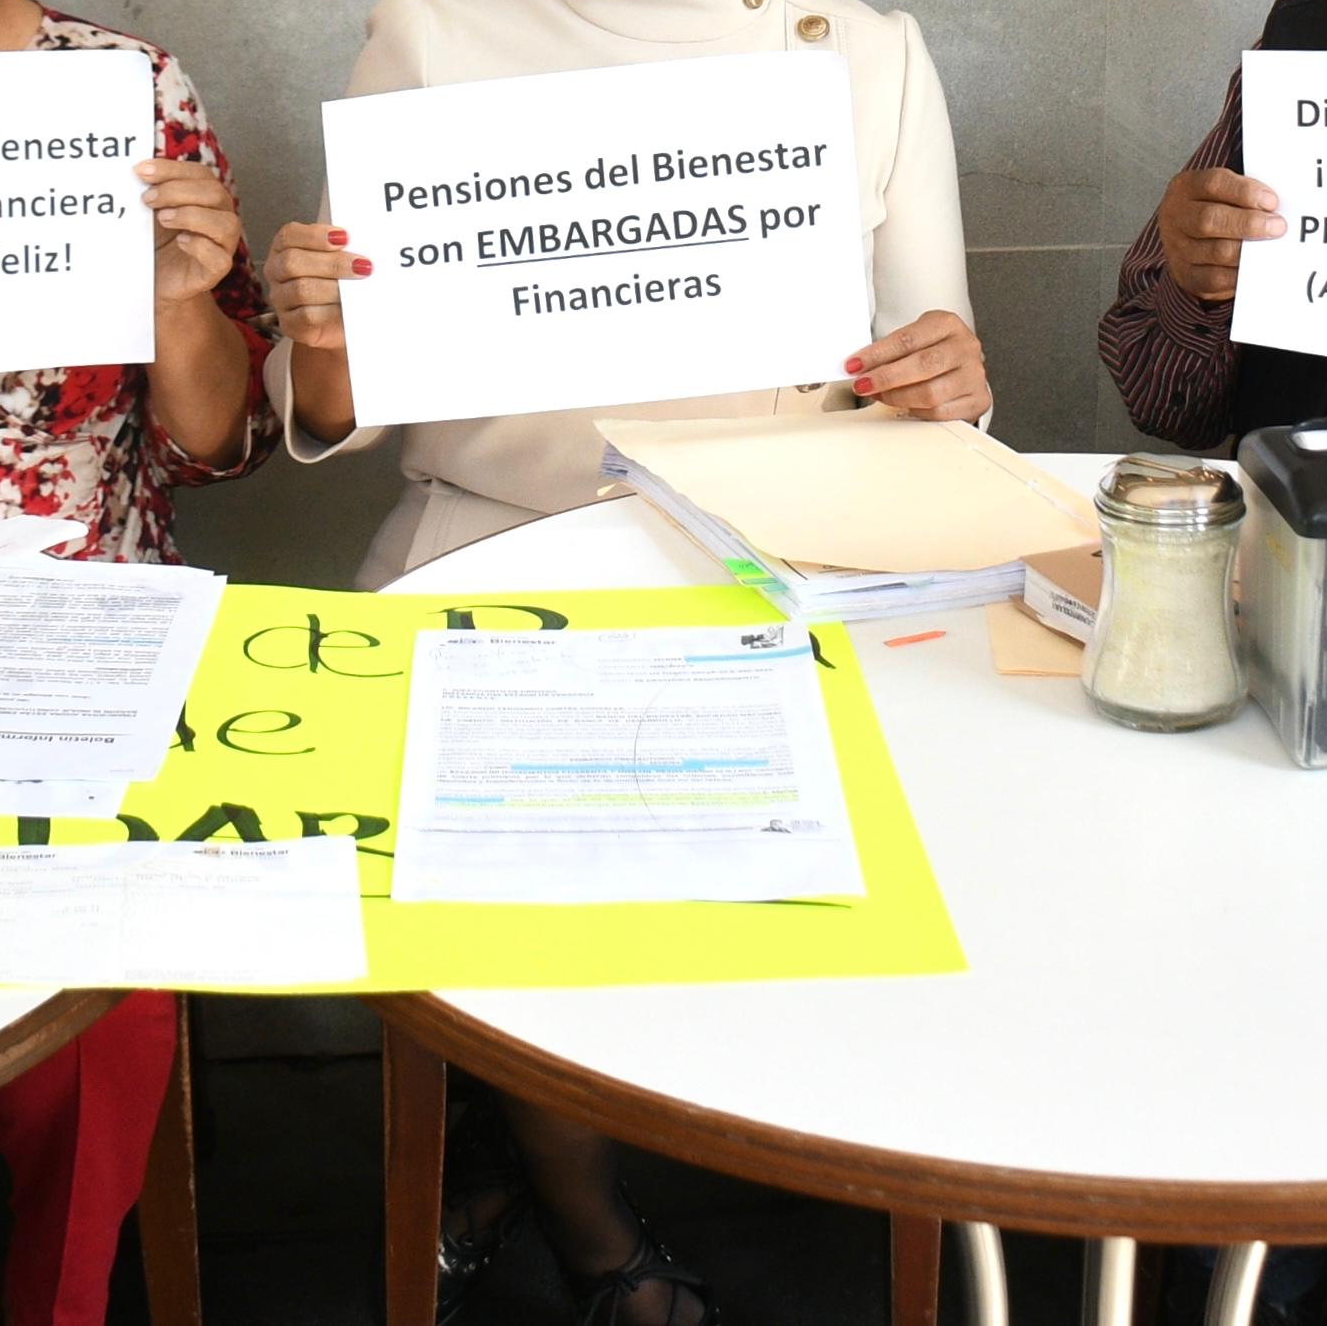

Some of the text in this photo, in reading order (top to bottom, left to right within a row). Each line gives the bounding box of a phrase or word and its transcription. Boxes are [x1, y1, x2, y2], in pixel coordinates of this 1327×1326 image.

[383, 143, 828, 213] Pensiones del Bienestar
[399, 203, 821, 268] son EMBARGADAS por
[512, 273, 722, 317] Financieras
